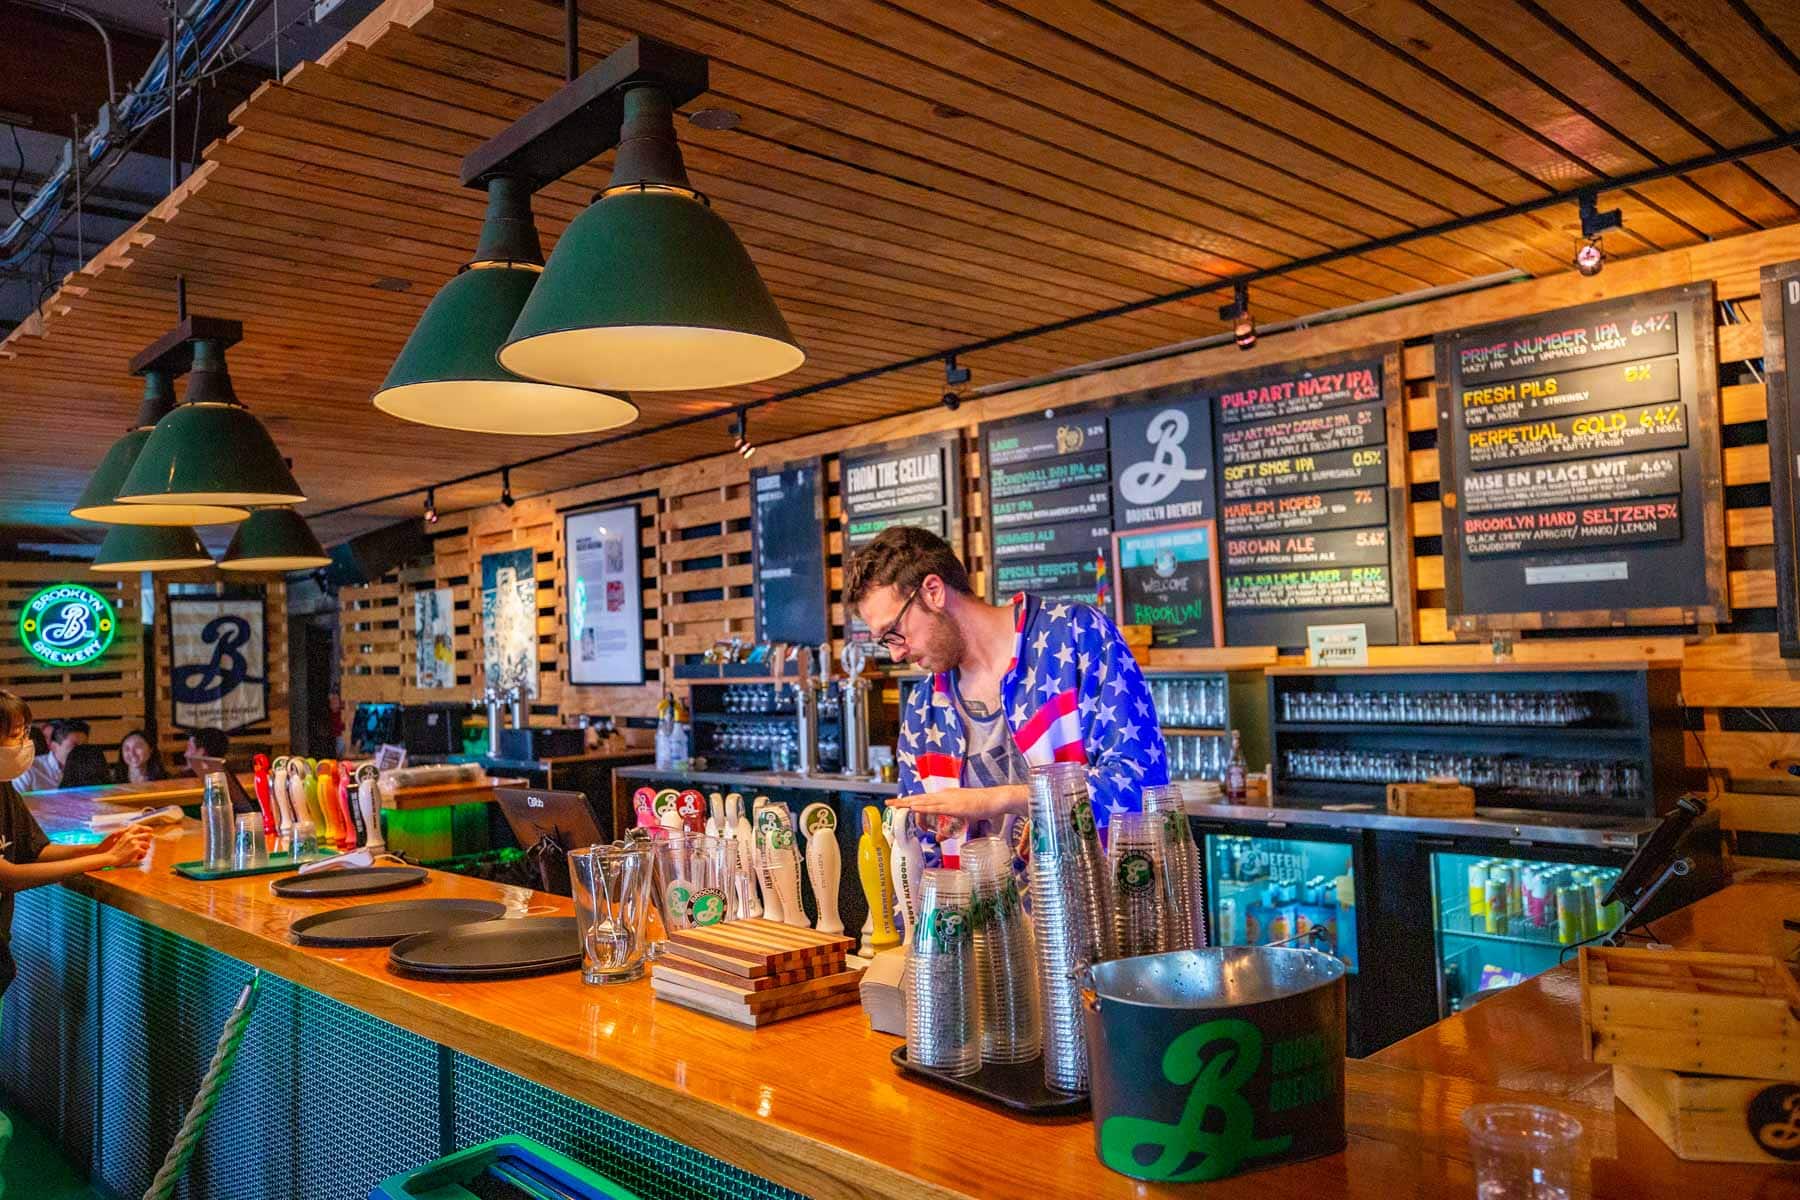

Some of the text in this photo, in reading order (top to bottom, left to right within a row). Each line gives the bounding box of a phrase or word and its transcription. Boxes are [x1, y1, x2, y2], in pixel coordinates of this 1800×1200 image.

[1460, 313, 1671, 365] PRIME NUMBER IPA 6.4%
[1298, 374, 1344, 396] HAZY
[1346, 369, 1373, 388] IPA
[1463, 384, 1515, 407] FRESH
[1520, 378, 1558, 400] PILS
[1469, 423, 1563, 448] PERPETUAL
[1572, 413, 1627, 436] GOLD
[1640, 405, 1680, 428] 6.4%
[847, 454, 939, 493] FROM THE CELLAR
[1225, 465, 1256, 480] SOFT
[1259, 461, 1290, 476] SHOE
[1295, 457, 1315, 472] IPA
[1464, 475, 1503, 492] MISE
[1508, 471, 1530, 487] EN
[1536, 466, 1587, 485] PLACE
[1592, 460, 1628, 478] WIT
[1225, 500, 1274, 518] HARLEM
[1465, 503, 1678, 533] BROOKLYN HARD SELTZER 5%
[1621, 522, 1657, 534] LEMON
[1228, 539, 1280, 556] BROWN
[1286, 537, 1315, 552] ALE
[1142, 577, 1189, 592] WELCOME
[32, 587, 104, 612] BROOKLYN
[33, 639, 101, 662] BREWERY
[901, 856, 916, 926] BROOKLYN LAGER
